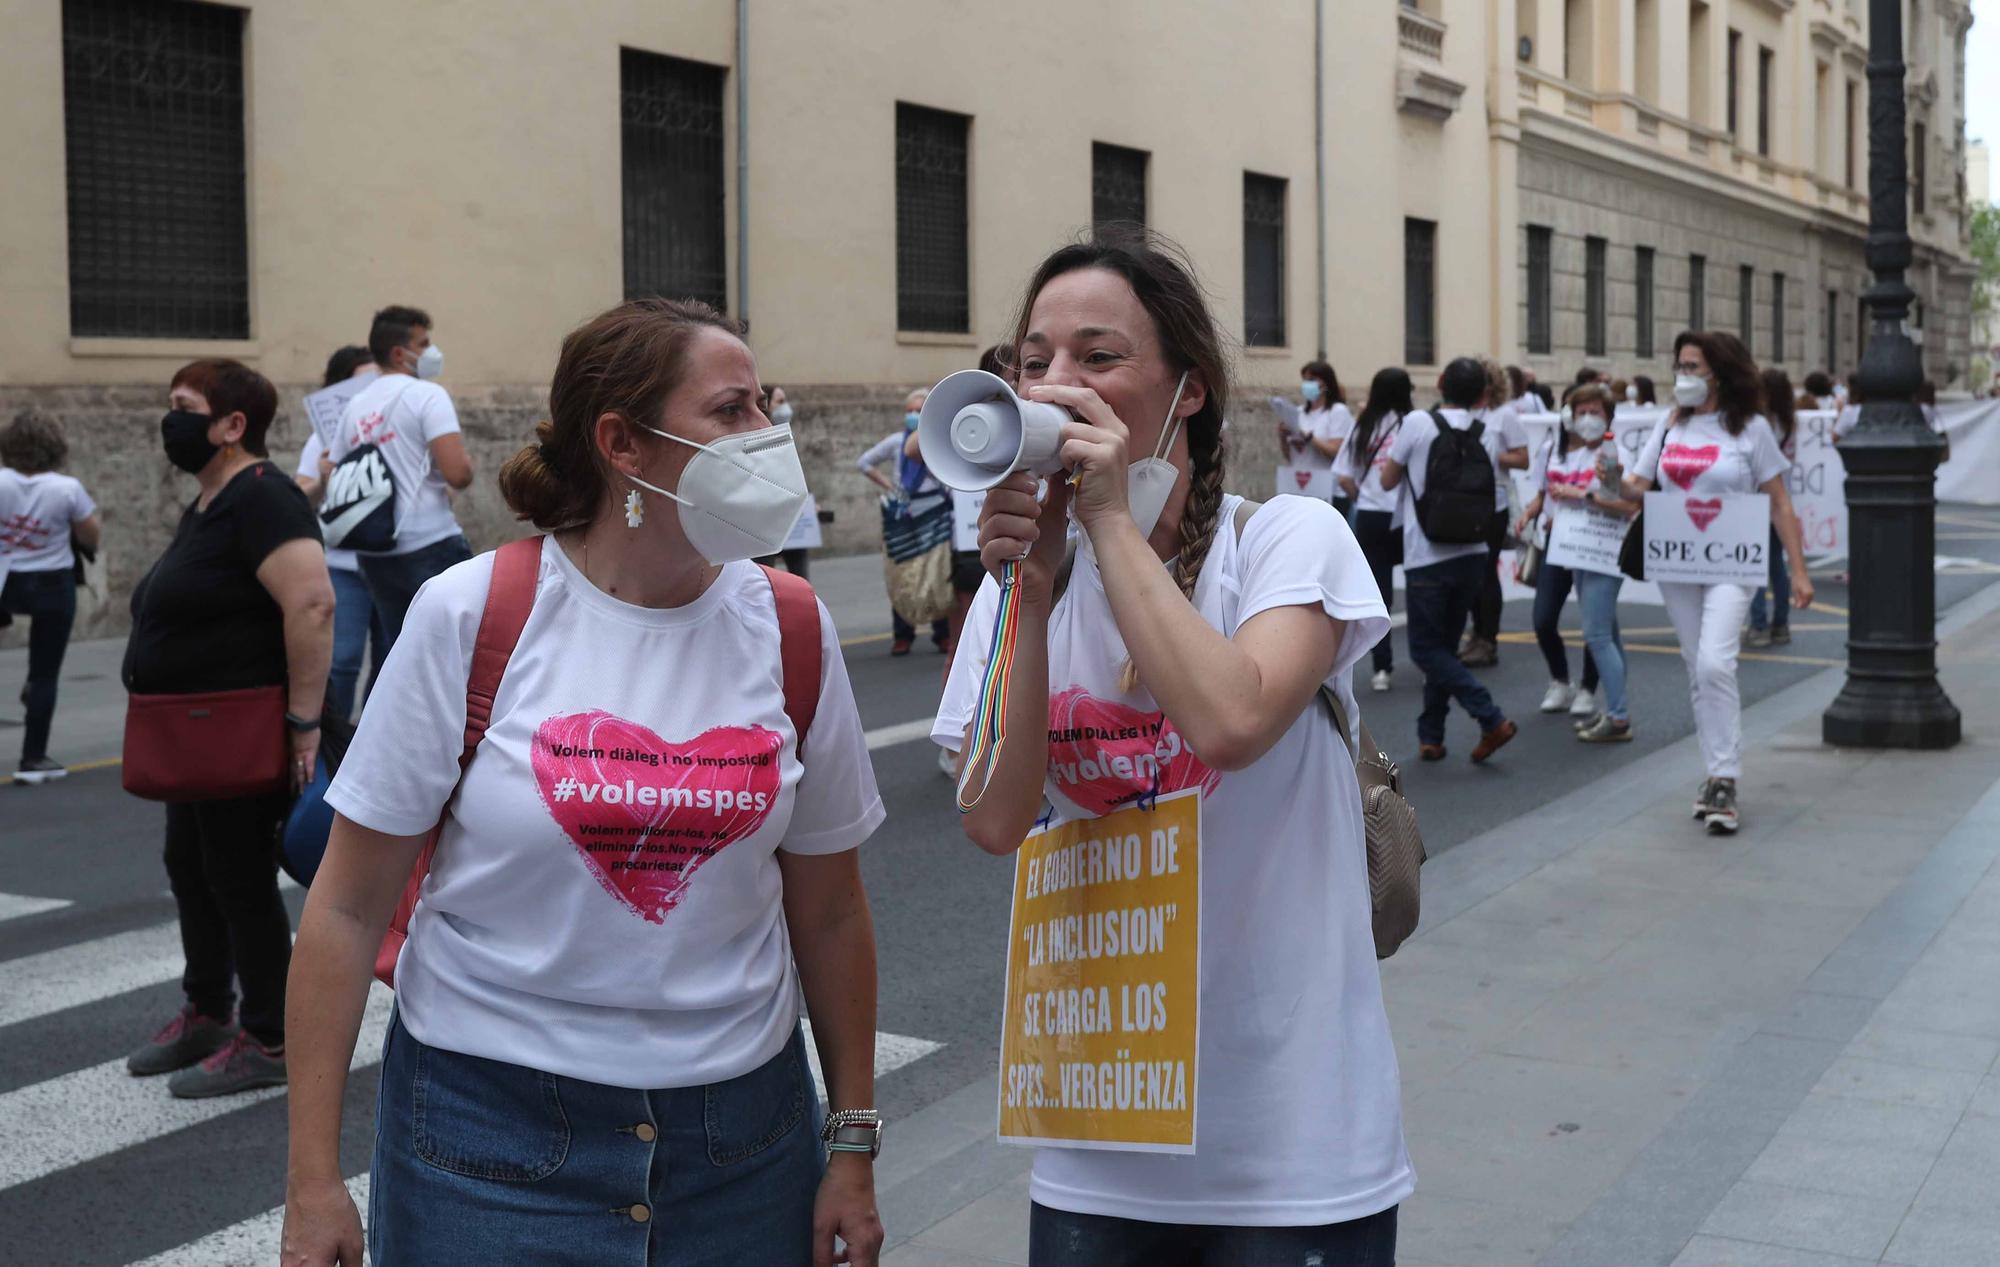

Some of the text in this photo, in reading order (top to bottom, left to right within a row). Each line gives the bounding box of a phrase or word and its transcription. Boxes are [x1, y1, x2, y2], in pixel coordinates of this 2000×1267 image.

[1648, 540, 1762, 564] SPE C-02
[552, 744, 769, 769] Volem diàleg i no imposició
[552, 777, 767, 817] #volemspes
[579, 824, 624, 836] Volem
[711, 831, 727, 840] no
[611, 859, 684, 872] precarietat
[1026, 825, 1179, 900] EL GOBIERNO DE
[1024, 981, 1167, 1038] SE CARGA LOS
